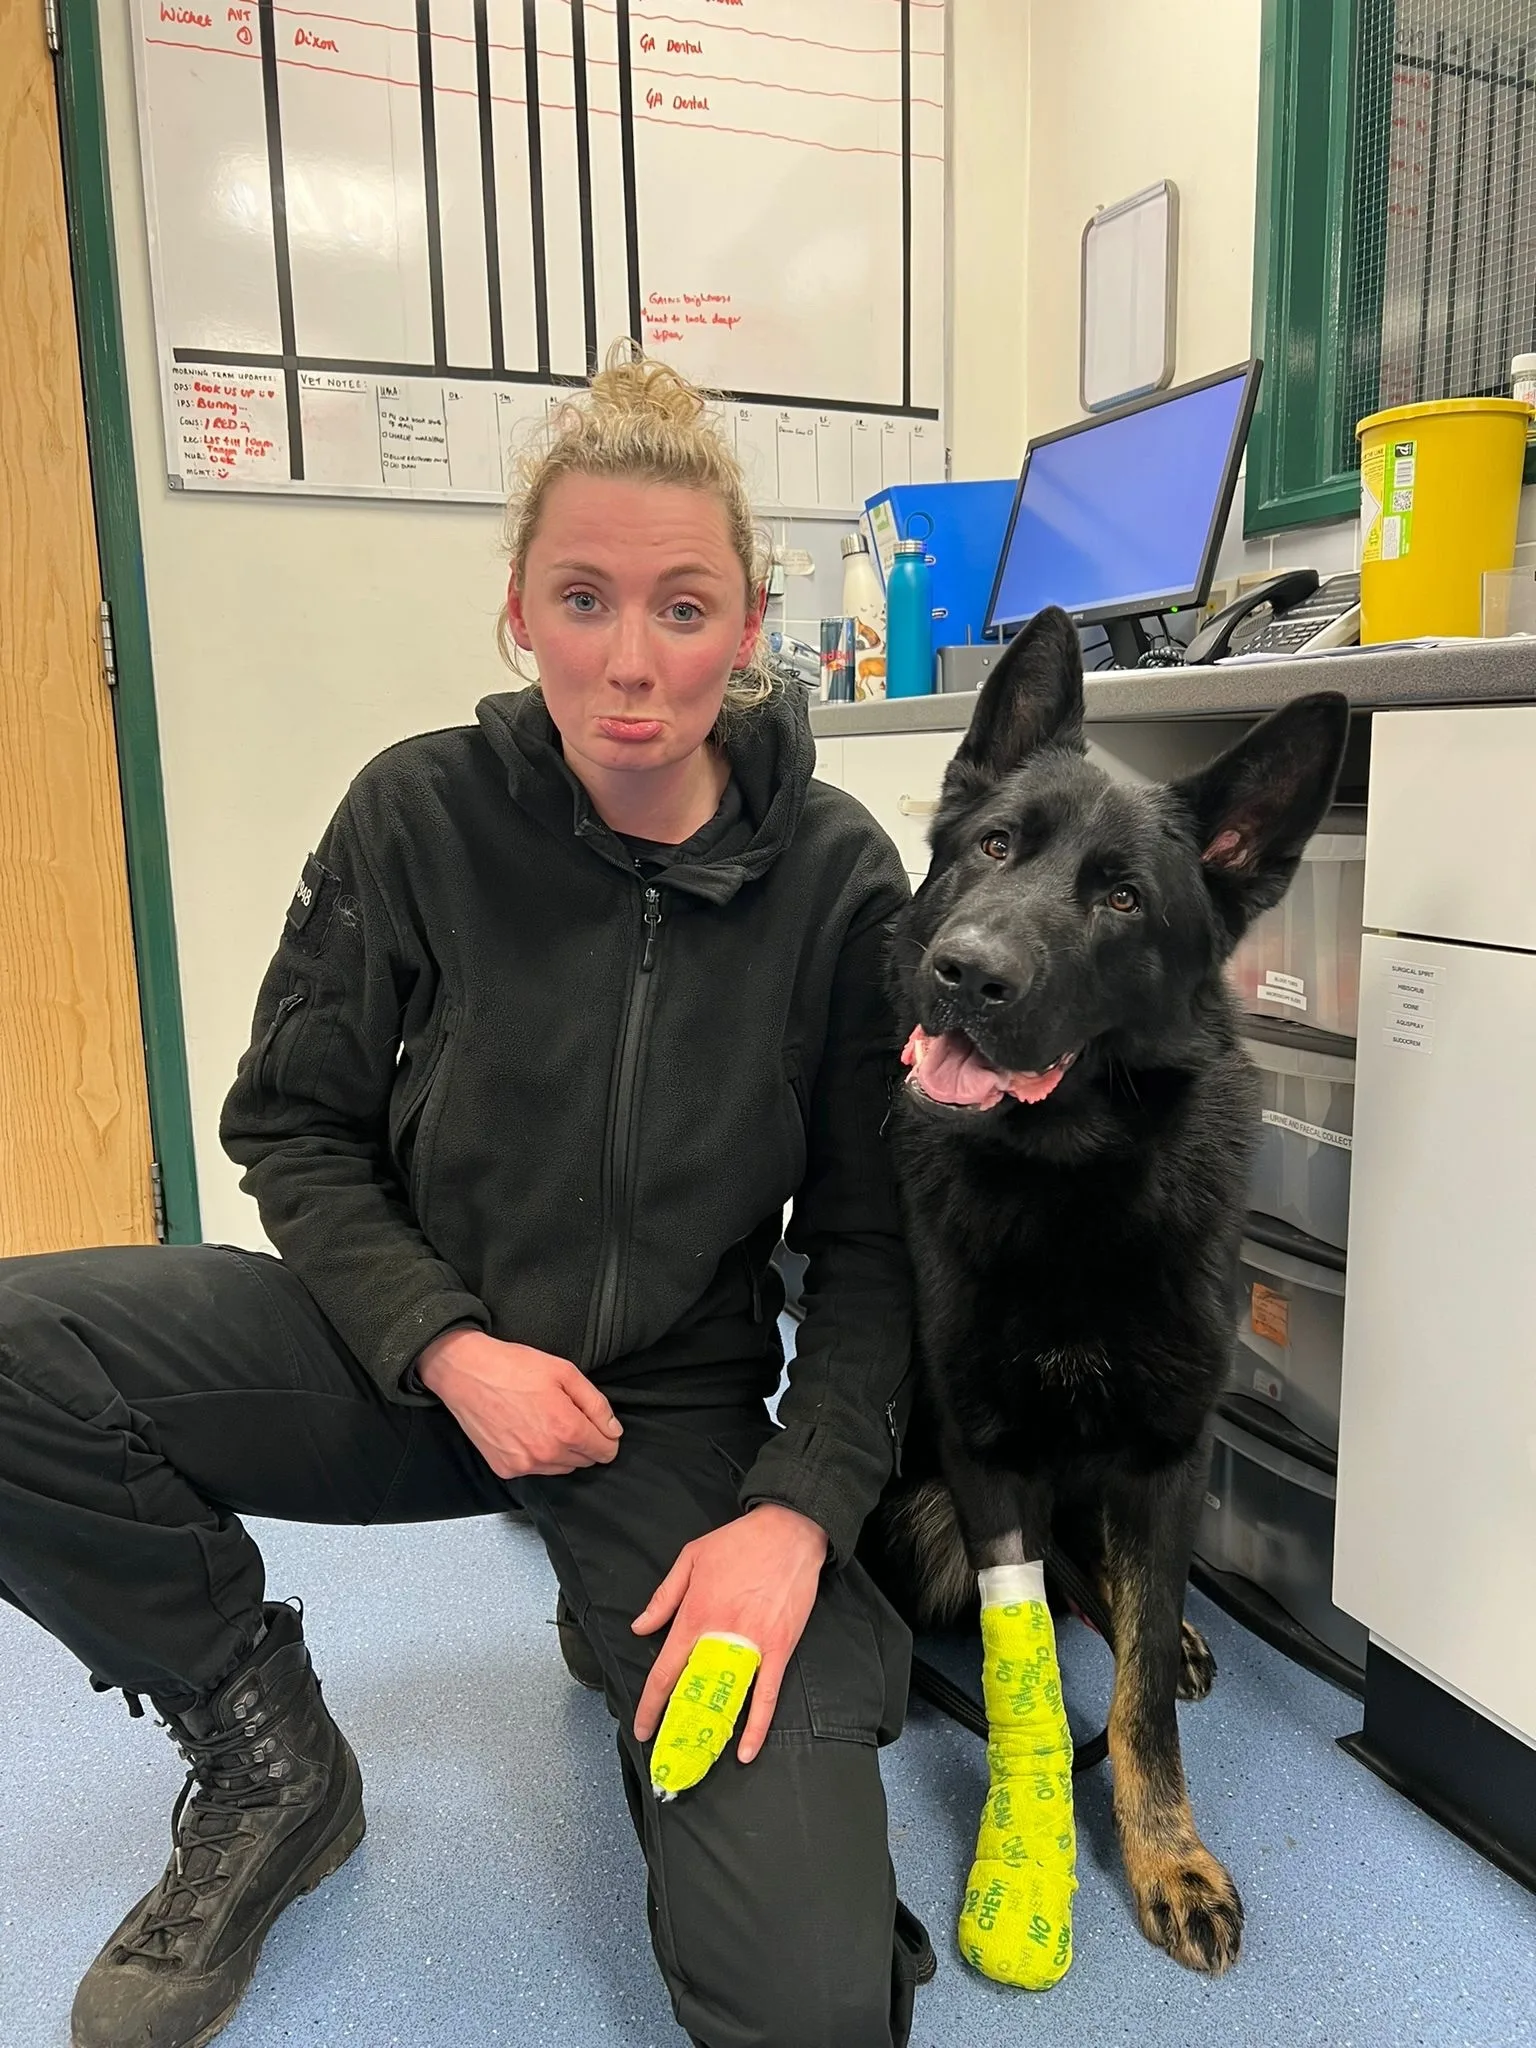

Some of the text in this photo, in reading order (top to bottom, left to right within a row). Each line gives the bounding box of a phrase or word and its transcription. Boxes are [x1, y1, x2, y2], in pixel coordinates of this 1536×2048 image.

[294, 28, 339, 53] Dixon
[667, 39, 702, 54] Dental
[673, 95, 709, 110] Dental
[172, 367, 209, 377] MORNING
[212, 371, 235, 379] TEAM
[224, 387, 237, 396] US
[1288, 1119, 1300, 1130] AND
[1027, 1915, 1051, 1948] NO
